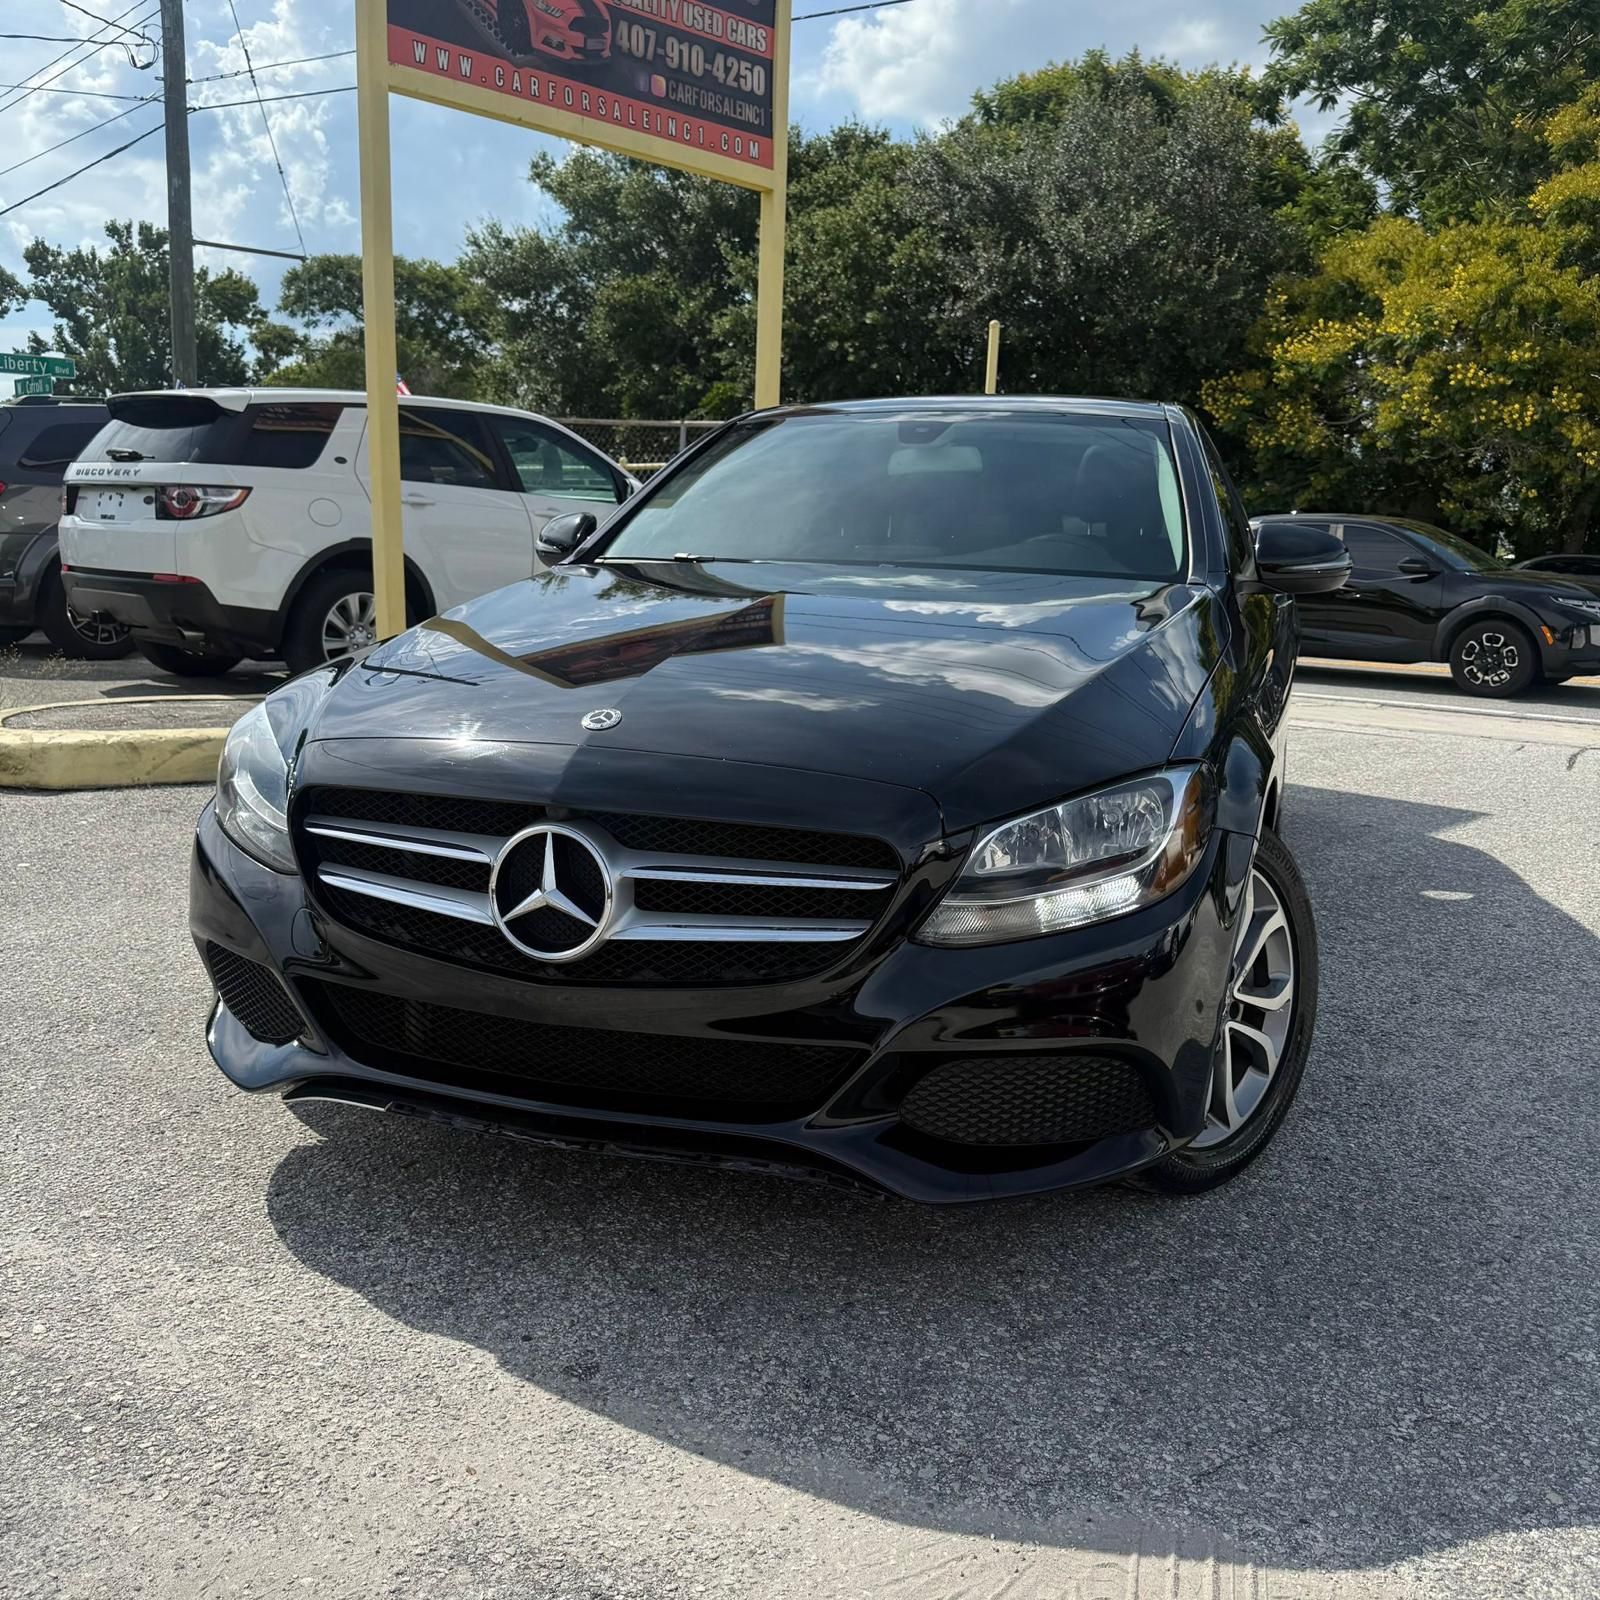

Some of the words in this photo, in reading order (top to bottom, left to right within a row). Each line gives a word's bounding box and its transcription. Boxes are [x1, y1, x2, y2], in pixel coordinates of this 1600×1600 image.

[615, 0, 681, 23] LITY
[682, 1, 724, 38] USED
[727, 17, 768, 52] CARS
[616, 19, 766, 96] 407-910-4250
[668, 79, 765, 126] CARFORSALEINC1
[0, 355, 47, 376] iberty
[55, 365, 70, 375] Blvd
[75, 467, 141, 477] DISCOVERY
